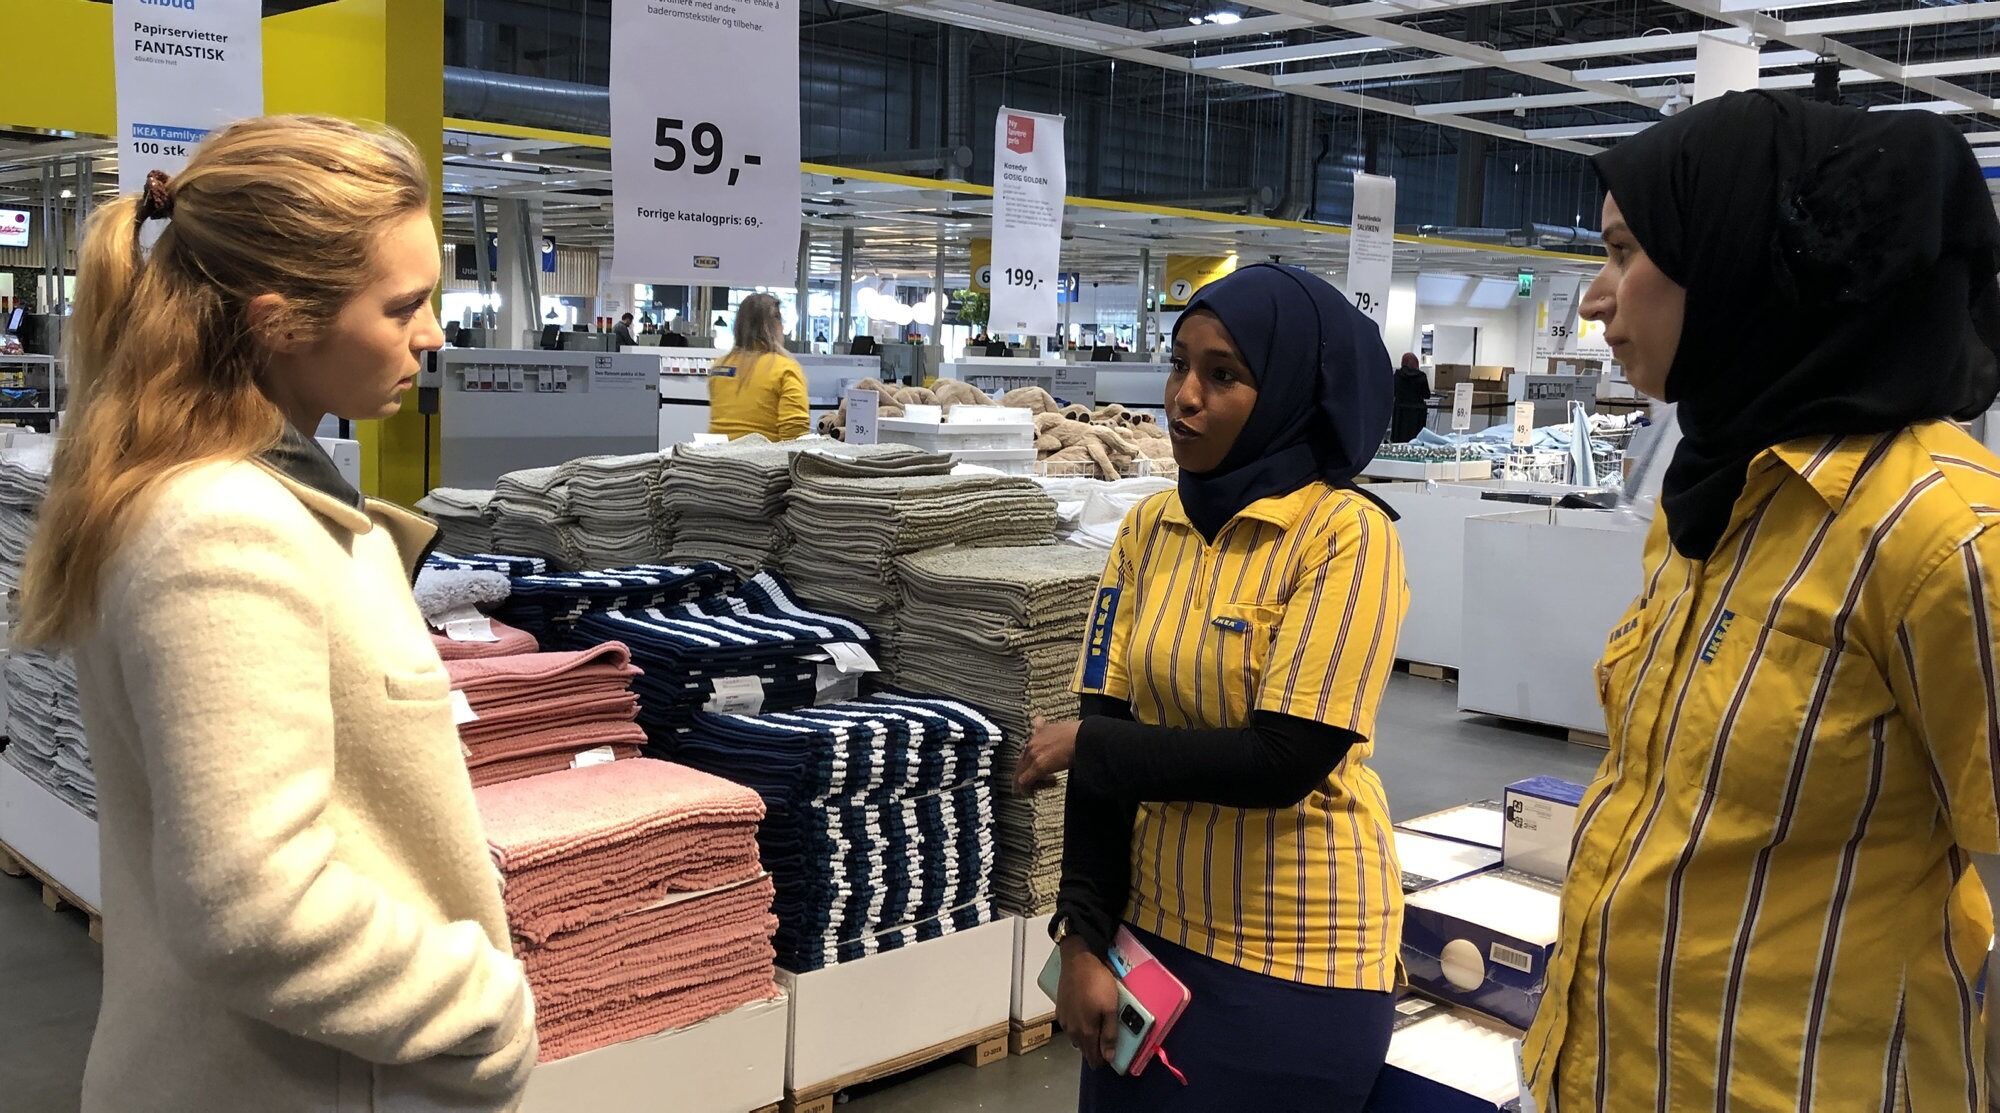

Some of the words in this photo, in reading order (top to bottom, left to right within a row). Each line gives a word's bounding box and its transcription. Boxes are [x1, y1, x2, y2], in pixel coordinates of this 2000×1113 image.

[695, 1, 712, 10] med
[713, 4, 736, 14] andre
[647, 5, 720, 23] baderomstekstiler
[722, 18, 732, 28] og
[134, 22, 228, 43] Papirservietter
[134, 40, 225, 61] FANTASTISK
[1008, 119, 1018, 129] Ny
[132, 126, 158, 137] IKEA
[1008, 128, 1027, 138] lavere
[1007, 137, 1020, 145] pris
[133, 142, 159, 154] 100
[163, 145, 189, 157] stk.
[653, 117, 761, 186] 59,-
[1003, 162, 1028, 172] Kosedyr
[1003, 173, 1023, 182] GOSIG
[1023, 175, 1048, 185] GOLDEN
[637, 207, 675, 222] Forrige
[677, 210, 742, 227] katalogpris:
[744, 216, 763, 228] 69,-
[694, 258, 718, 267] IKEA
[981, 270, 991, 284] 6
[1005, 267, 1043, 290] 199,-
[1176, 284, 1185, 296] 7
[1355, 292, 1379, 314] 79,-
[1551, 326, 1573, 339] 35,-
[1456, 407, 1468, 418] 69,-
[855, 425, 869, 436] 39,-
[1516, 424, 1529, 435] 49,-
[1091, 593, 1112, 656] IKEA
[1215, 618, 1236, 628] IKEA
[1609, 617, 1638, 644] IKEA
[1706, 618, 1733, 660] IKEA
